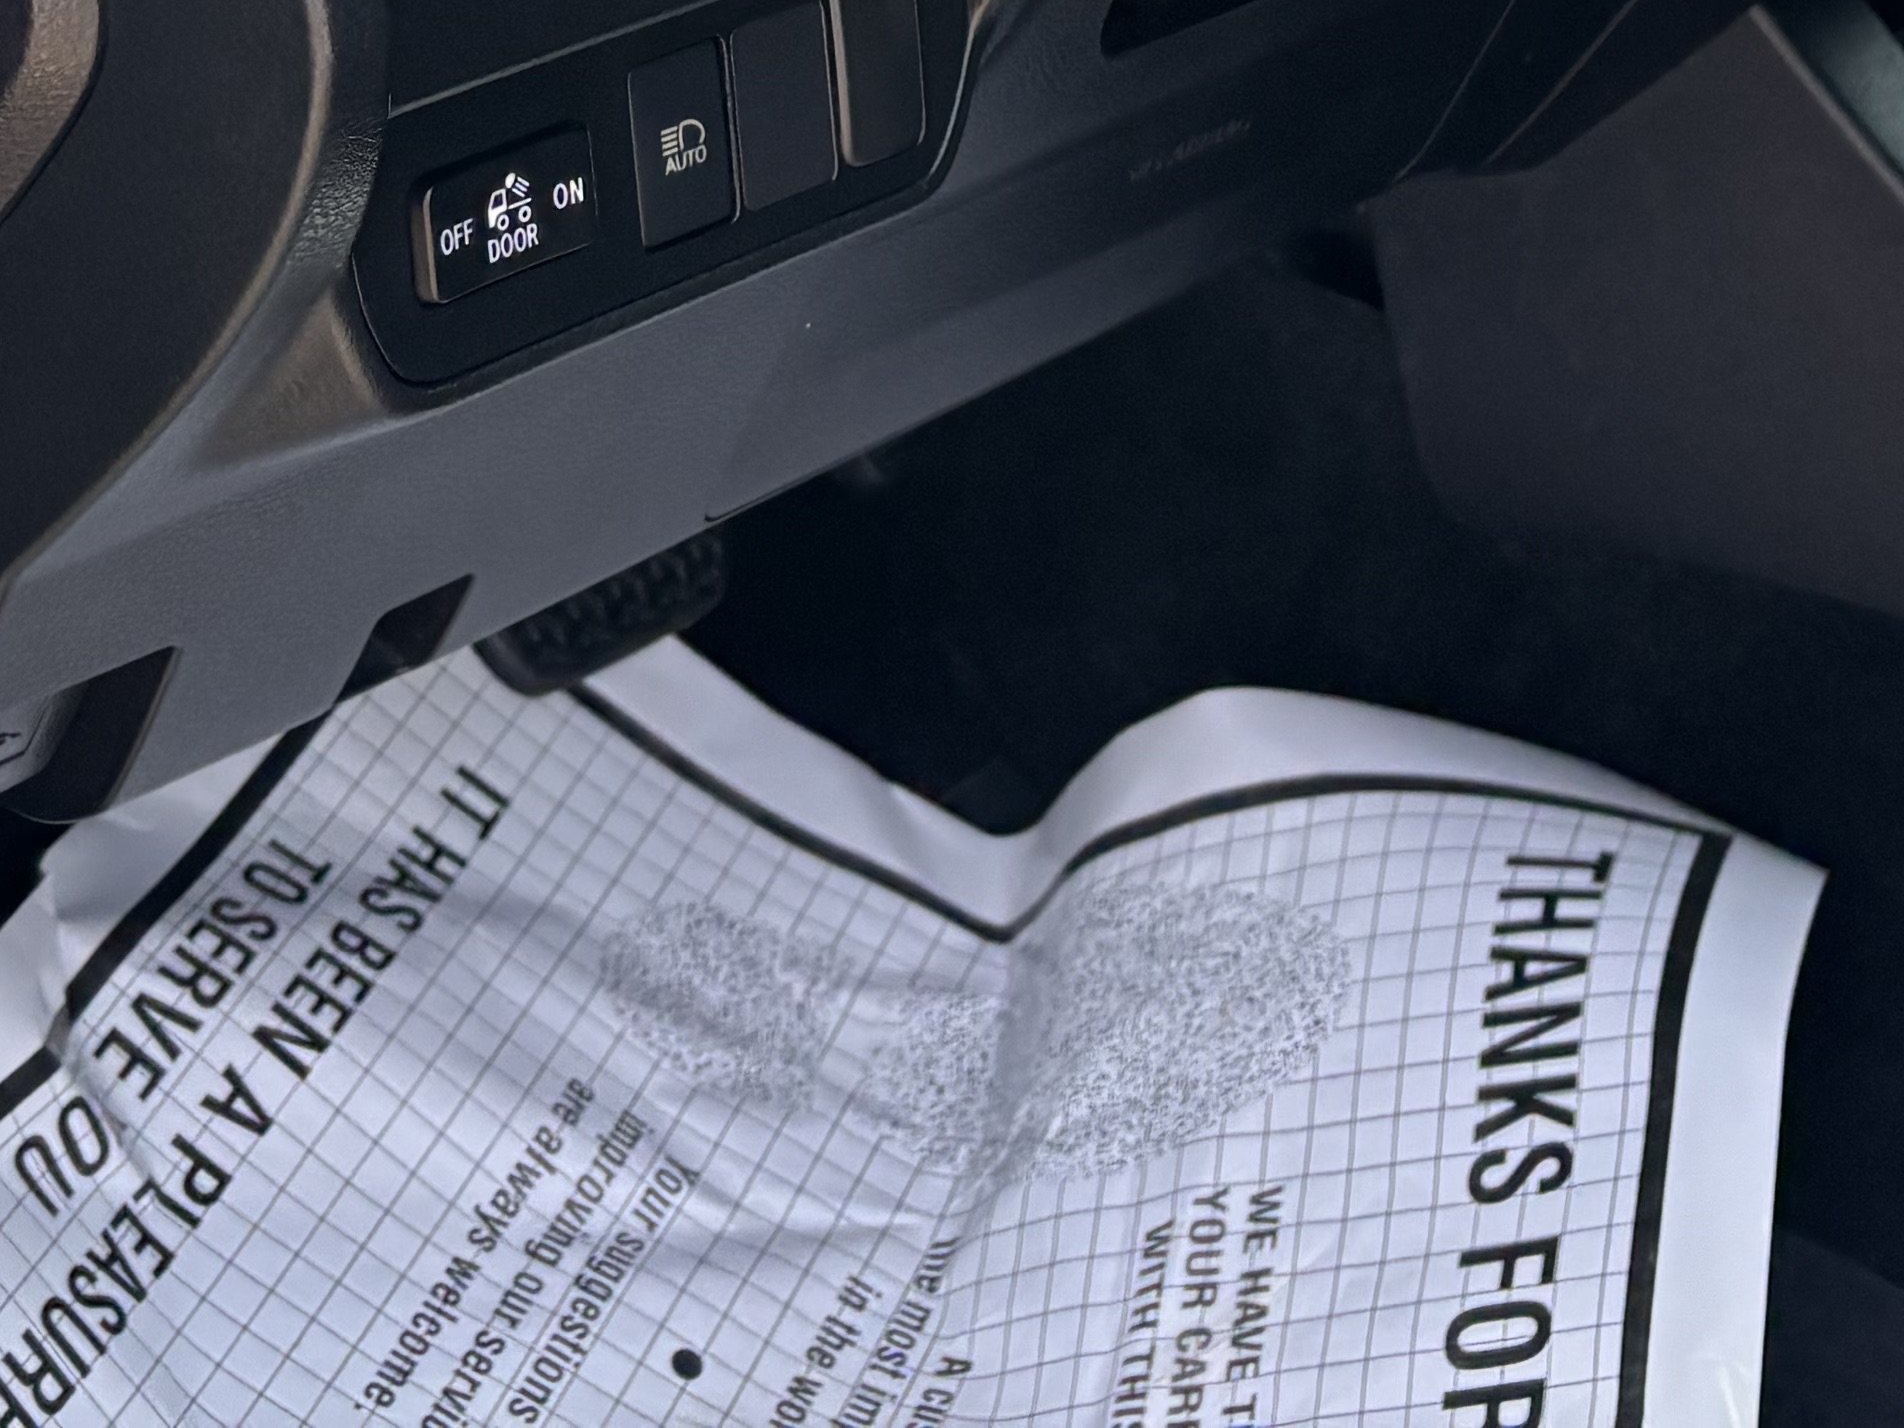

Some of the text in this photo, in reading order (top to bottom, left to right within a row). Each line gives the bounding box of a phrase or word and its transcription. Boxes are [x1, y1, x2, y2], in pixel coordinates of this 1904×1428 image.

[553, 176, 584, 210] ON
[665, 144, 707, 176] AUTO
[440, 218, 474, 256] OFF
[487, 222, 539, 264] DOOR
[440, 766, 510, 842] IT
[359, 825, 467, 934] HAS
[14, 838, 332, 1218] TO SERVE OU
[252, 919, 397, 1081] BEEN
[1468, 851, 1616, 1205] THANKS
[199, 1066, 274, 1137] A
[523, 1109, 655, 1268] improving
[353, 1077, 595, 1411] are always welcome.
[508, 1153, 700, 1424] Your suggestions
[1127, 1219, 1175, 1333] WITH
[1181, 1185, 1232, 1310] YOUR
[493, 1270, 545, 1329] our
[769, 1274, 883, 1428] in the wo
[869, 1300, 932, 1380] most
[1221, 1185, 1285, 1428] WE HAVE T
[830, 1383, 898, 1428] im
[906, 1356, 974, 1428] A cu
